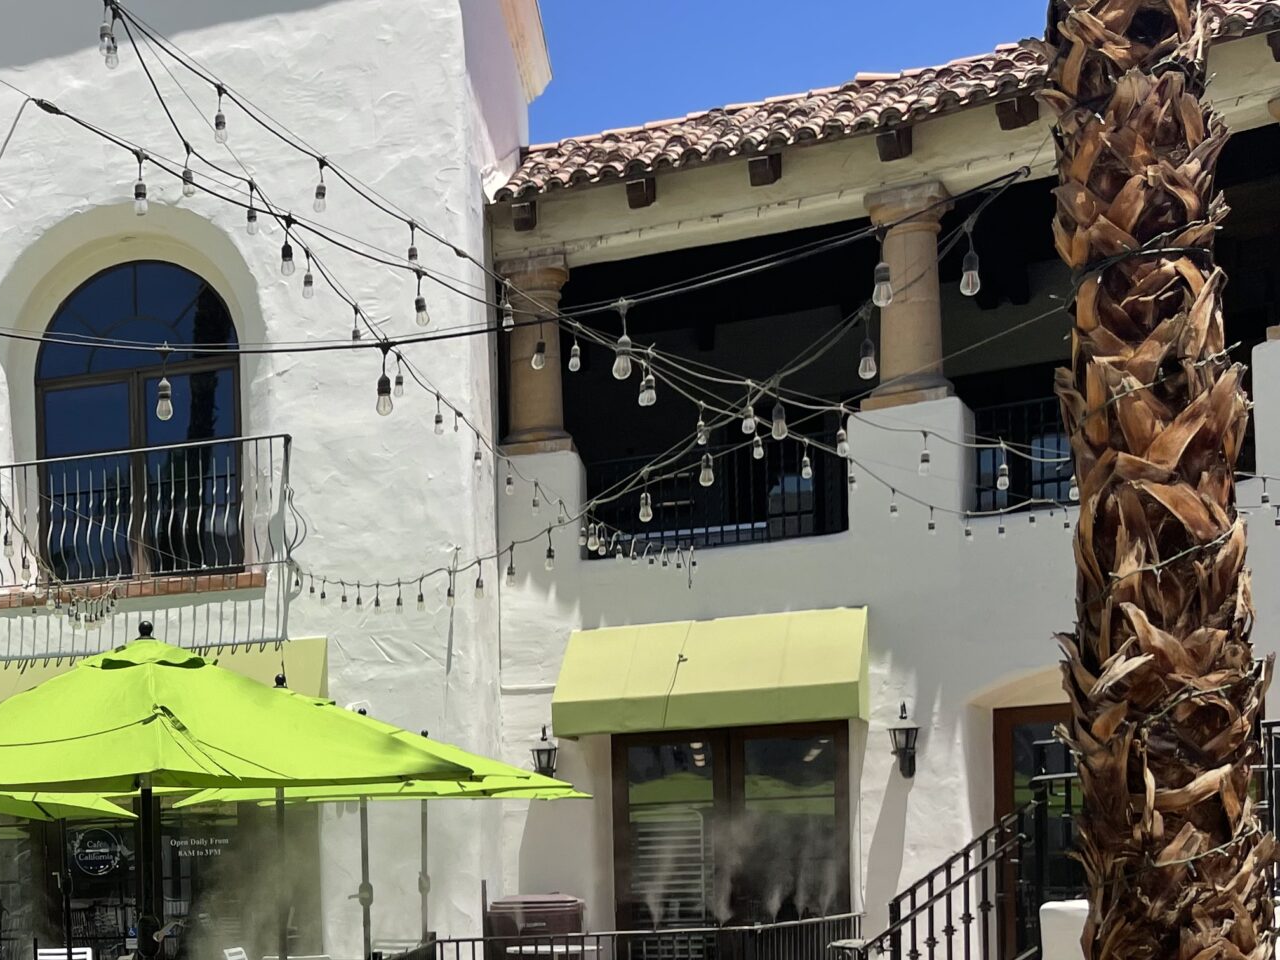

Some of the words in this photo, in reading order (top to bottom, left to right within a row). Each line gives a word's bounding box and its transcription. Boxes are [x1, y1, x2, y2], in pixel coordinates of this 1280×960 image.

[170, 839, 189, 847] Open
[190, 838, 207, 846] Daily
[210, 837, 229, 845] From
[79, 852, 113, 861] California
